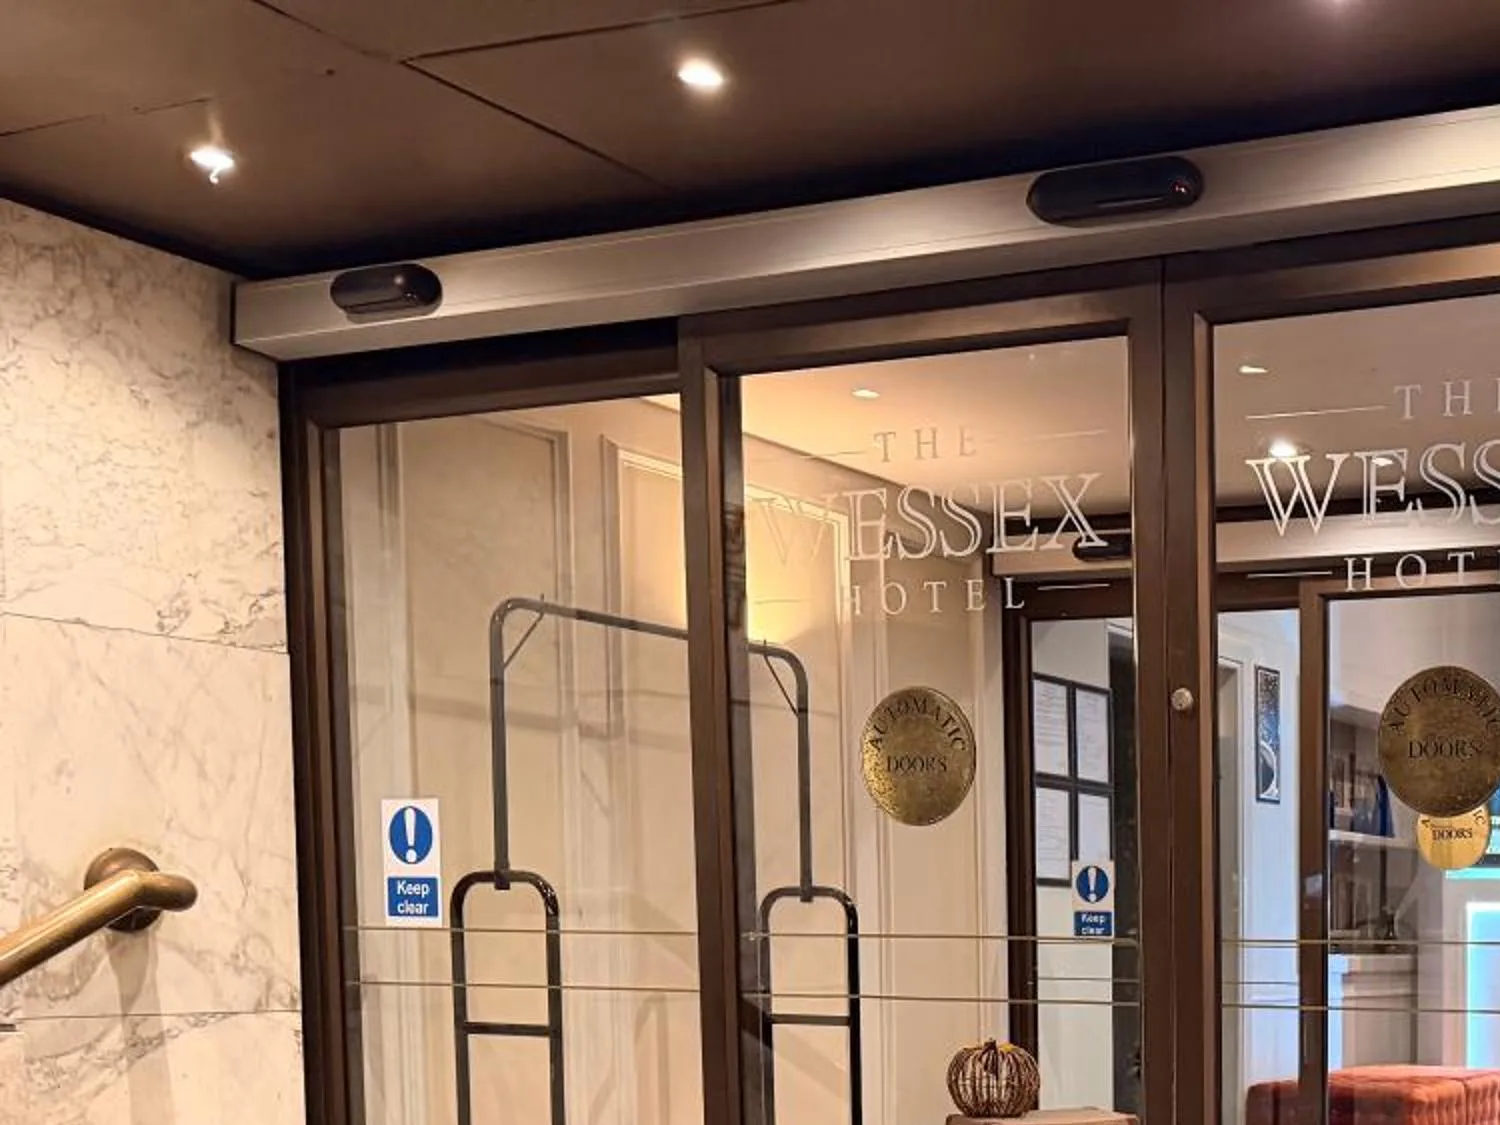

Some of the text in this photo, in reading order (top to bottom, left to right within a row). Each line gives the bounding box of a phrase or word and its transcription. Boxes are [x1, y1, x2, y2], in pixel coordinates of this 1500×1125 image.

[874, 426, 978, 463] THE
[752, 472, 1109, 567] WESSEX
[868, 697, 967, 752] AUTOMATIC
[1408, 739, 1483, 759] DOORS
[887, 755, 948, 775] DOORS
[396, 879, 430, 898] Keep
[396, 900, 429, 914] clear
